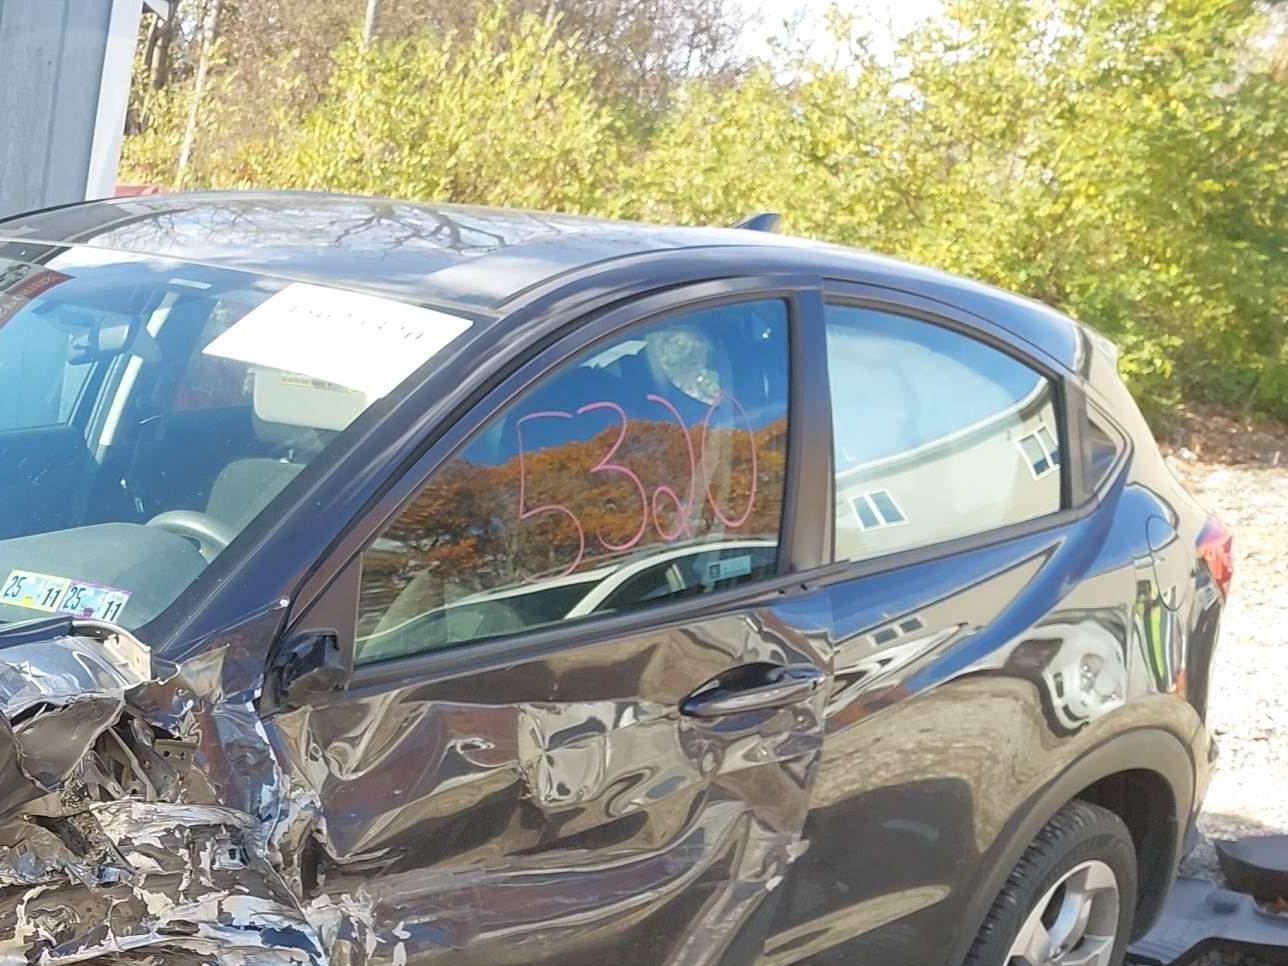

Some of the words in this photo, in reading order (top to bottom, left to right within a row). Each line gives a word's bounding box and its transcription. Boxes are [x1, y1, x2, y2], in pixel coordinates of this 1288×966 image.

[3, 575, 27, 598] 25
[41, 587, 62, 608] 11
[63, 586, 87, 610] 25
[102, 600, 123, 621] 11
